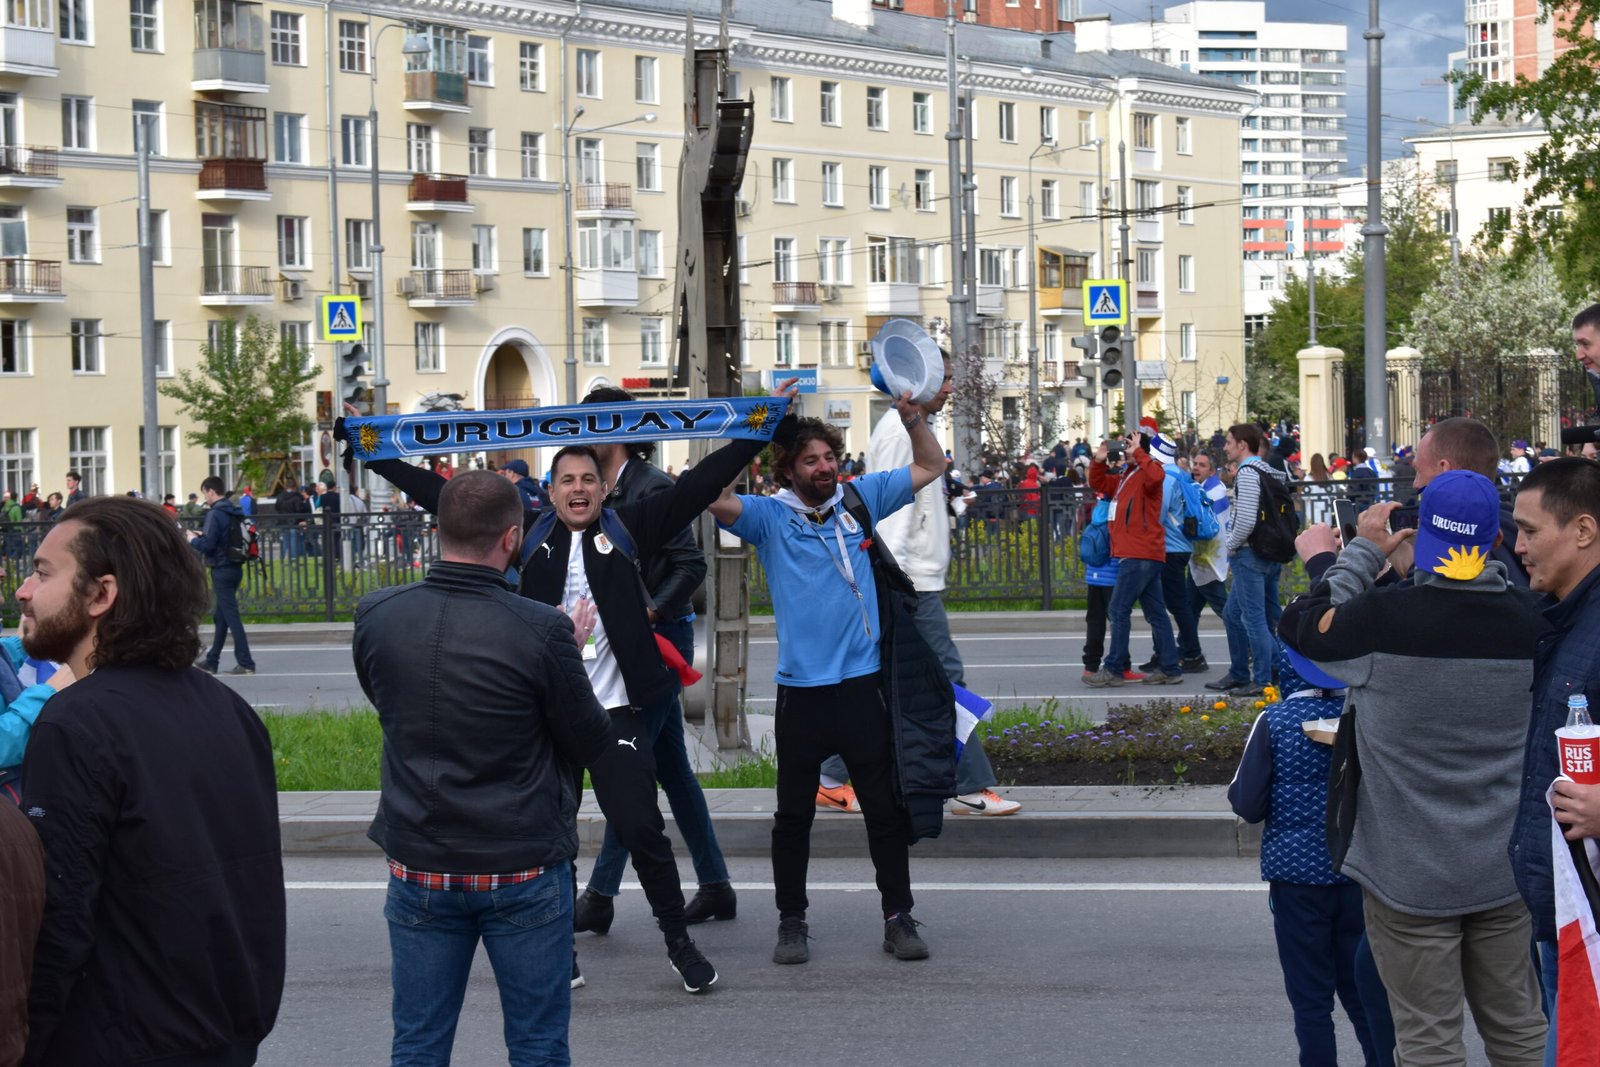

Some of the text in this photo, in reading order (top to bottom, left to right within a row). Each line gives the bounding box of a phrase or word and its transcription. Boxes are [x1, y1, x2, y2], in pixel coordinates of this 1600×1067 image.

[413, 408, 715, 445] URUGUAY
[760, 402, 781, 436] URUGUAY
[1432, 514, 1479, 535] URUGUAY
[1565, 747, 1592, 760] RUS
[1566, 760, 1593, 773] SIA
